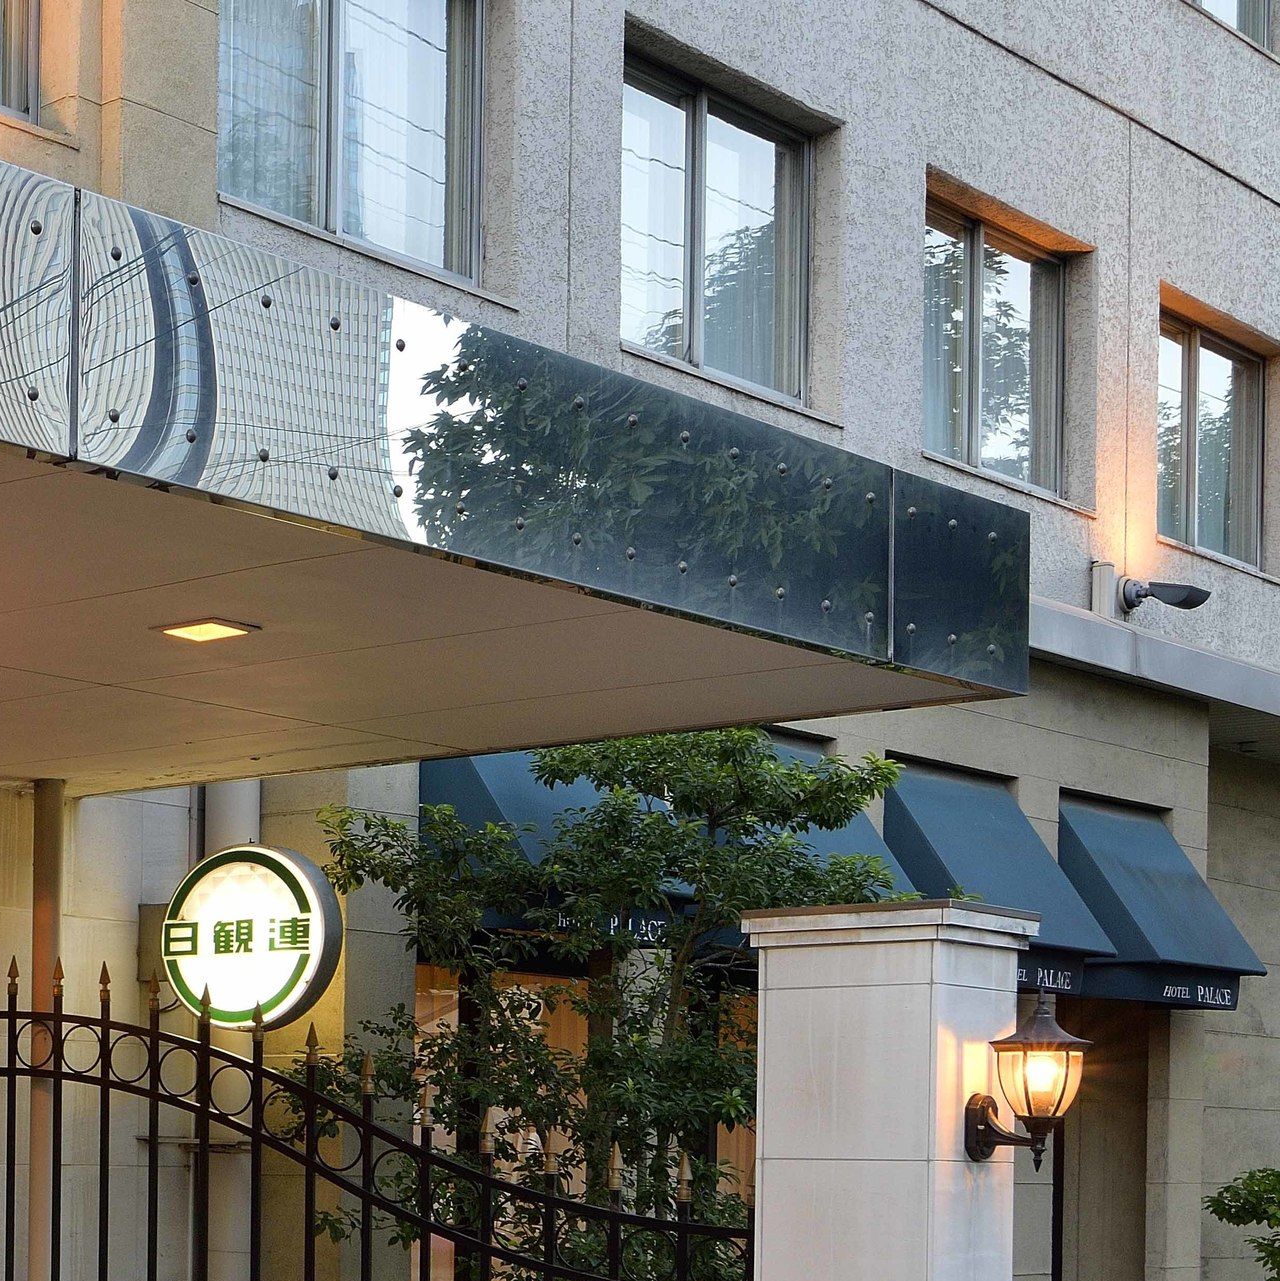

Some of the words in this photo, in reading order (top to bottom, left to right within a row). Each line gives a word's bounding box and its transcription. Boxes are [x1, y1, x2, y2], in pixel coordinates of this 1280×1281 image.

[164, 917, 311, 957] 日観連
[1036, 967, 1072, 990] PALACE
[1163, 985, 1191, 999] HOTEL
[1197, 985, 1232, 1006] PALACE
